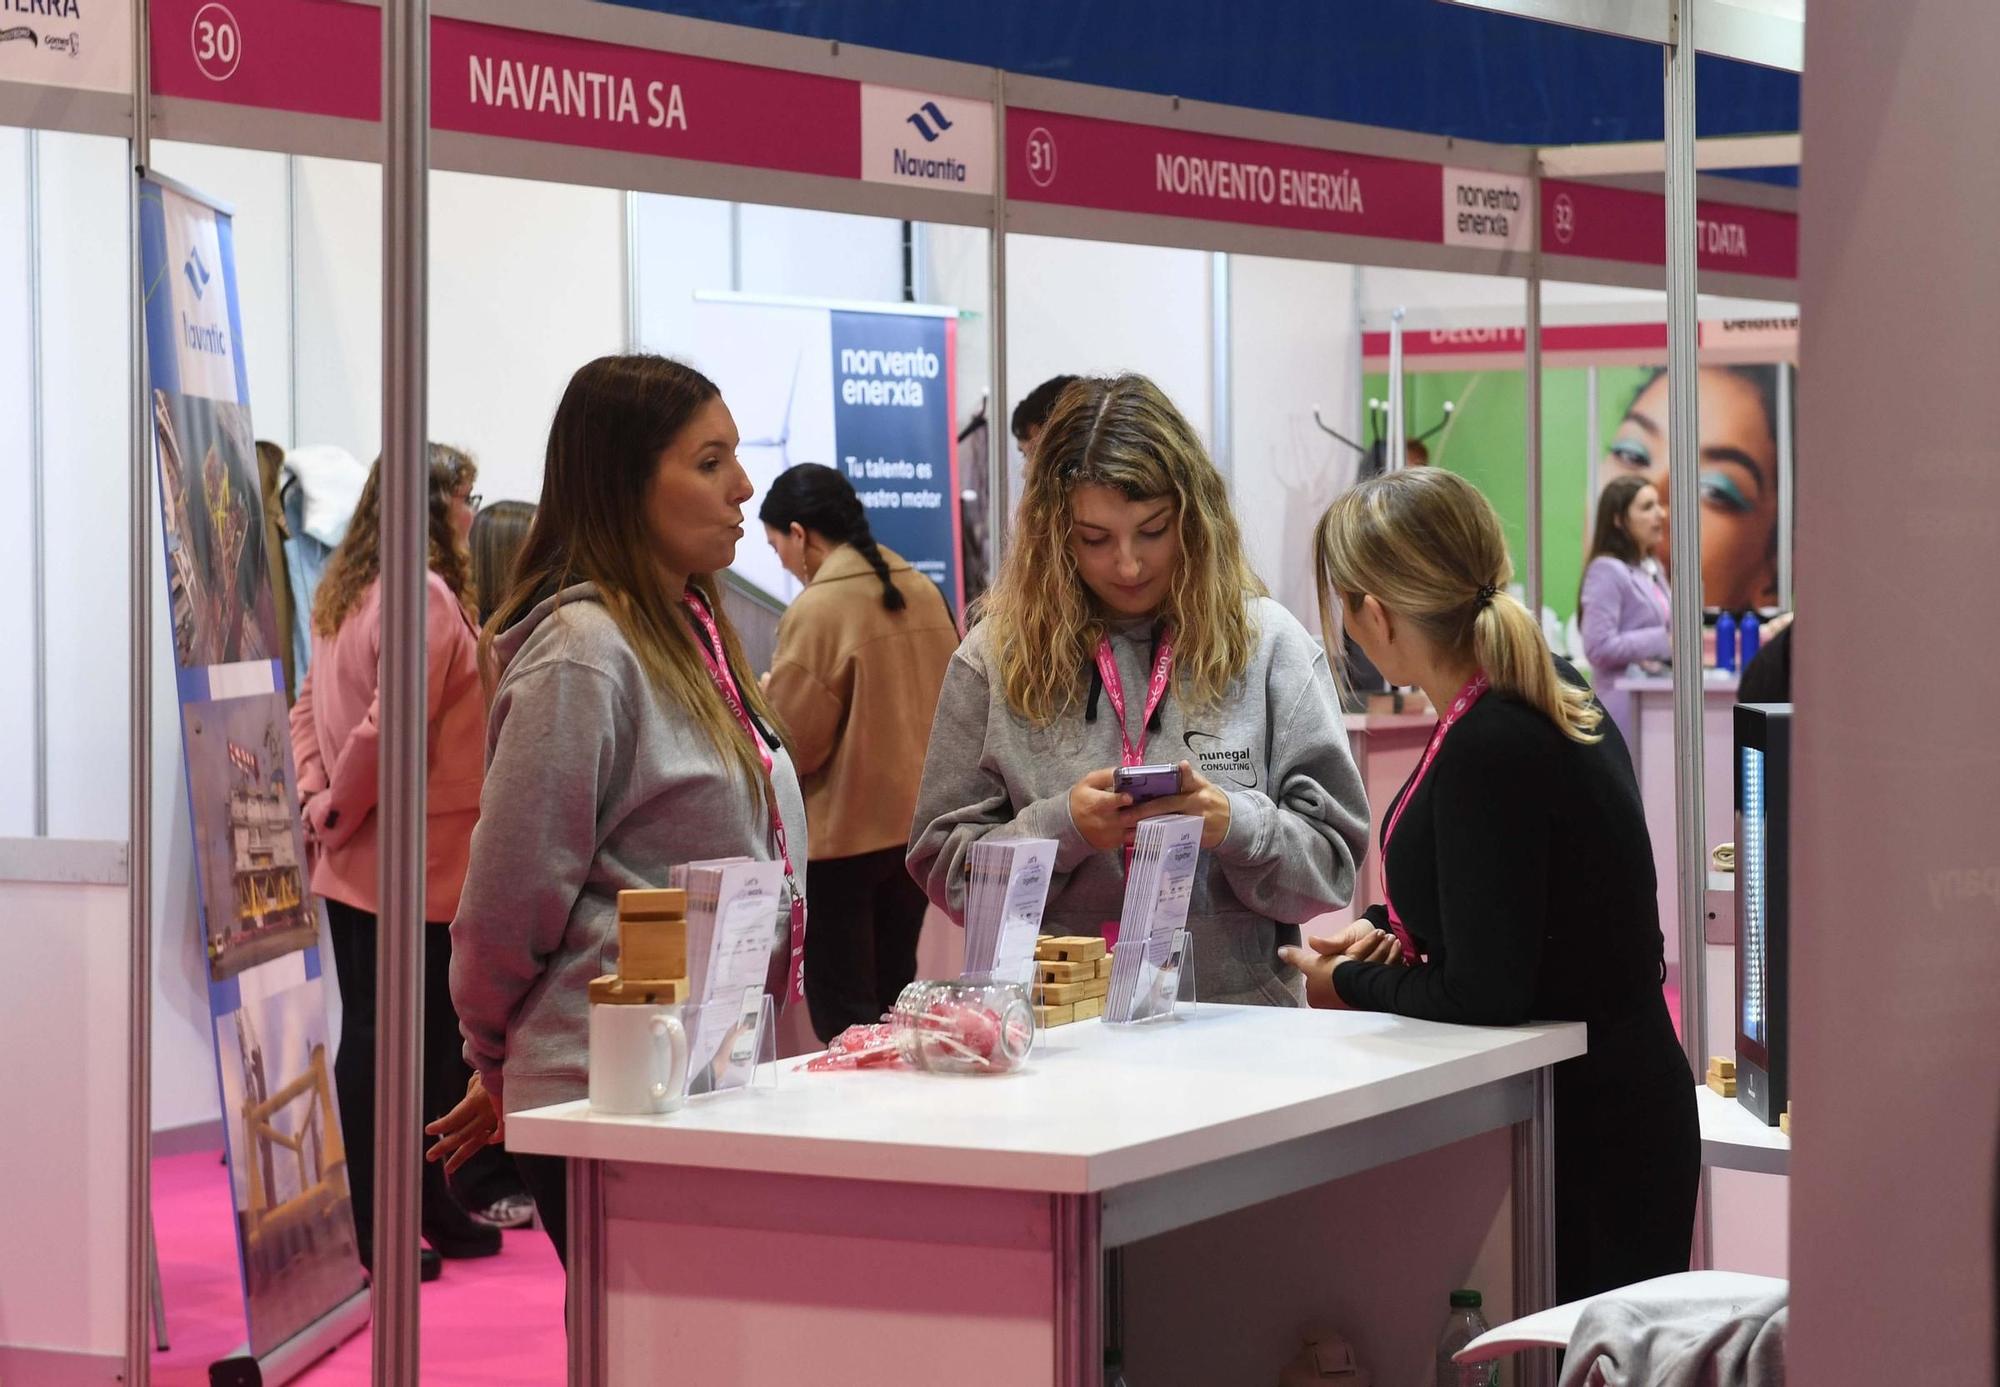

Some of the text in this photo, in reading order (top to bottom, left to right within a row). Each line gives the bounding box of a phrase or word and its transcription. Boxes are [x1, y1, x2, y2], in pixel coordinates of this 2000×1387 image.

[199, 21, 235, 63] 30
[469, 55, 688, 131] NAVANTIA SA
[893, 147, 966, 182] Navantia
[1030, 140, 1051, 171] 31
[1156, 152, 1365, 214] NORVENTO ENERXÍA
[1457, 185, 1520, 212] norvento
[1708, 221, 1748, 257] DATA
[841, 346, 940, 379] norvento
[842, 377, 924, 407] enerxía
[845, 456, 933, 480] Tu talento es
[856, 488, 942, 508] uestro motor
[1155, 656, 1169, 683] UDC
[1199, 747, 1250, 762] nunegal
[1201, 762, 1250, 771] CONSULTING
